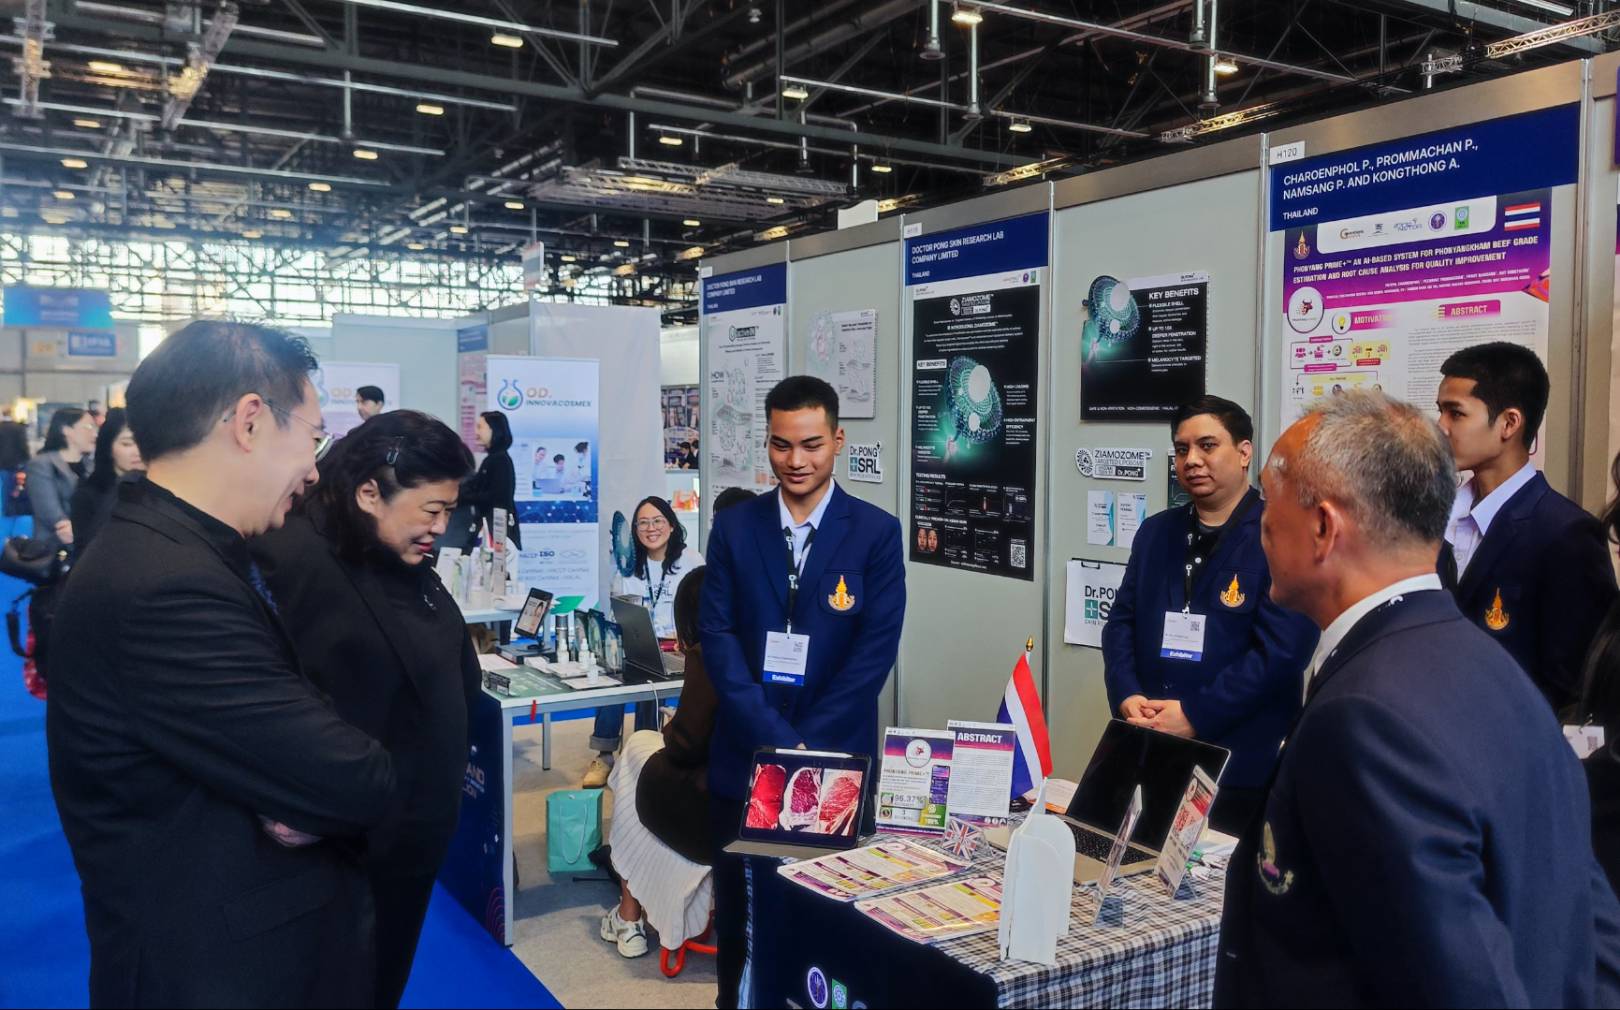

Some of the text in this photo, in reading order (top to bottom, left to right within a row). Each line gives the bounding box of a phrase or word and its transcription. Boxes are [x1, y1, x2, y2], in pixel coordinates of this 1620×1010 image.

[1283, 138, 1478, 186] CHAROENPHOL P., PROMMACHAN P.,
[1283, 157, 1460, 200] NAMSANG P. AND KONGTHONG A.
[1282, 207, 1319, 220] THAILAND
[911, 230, 1004, 255] DOCTOR PONG SKIN RESEARCH LAB
[1353, 258, 1362, 266] AN
[1363, 254, 1393, 265] AI-BASED
[1393, 250, 1419, 261] SYSTEM
[1420, 248, 1433, 257] FOR
[1492, 239, 1511, 248] BEEF
[1513, 235, 1539, 246] GRADE
[911, 249, 959, 265] COMPANY LIMITED
[1293, 251, 1507, 284] ESTIMATION AND ROOT CAUSE ANALYSIS FOR QUALITY IMPROVEMENT
[1148, 287, 1200, 301] KEY BENEFITS
[1450, 304, 1488, 316] ABSTRACT
[525, 399, 591, 408] INNOVACOSMEX
[850, 445, 878, 457] Dr.PONG
[857, 457, 881, 474] SRL
[957, 732, 1003, 744] ABSTRACT
